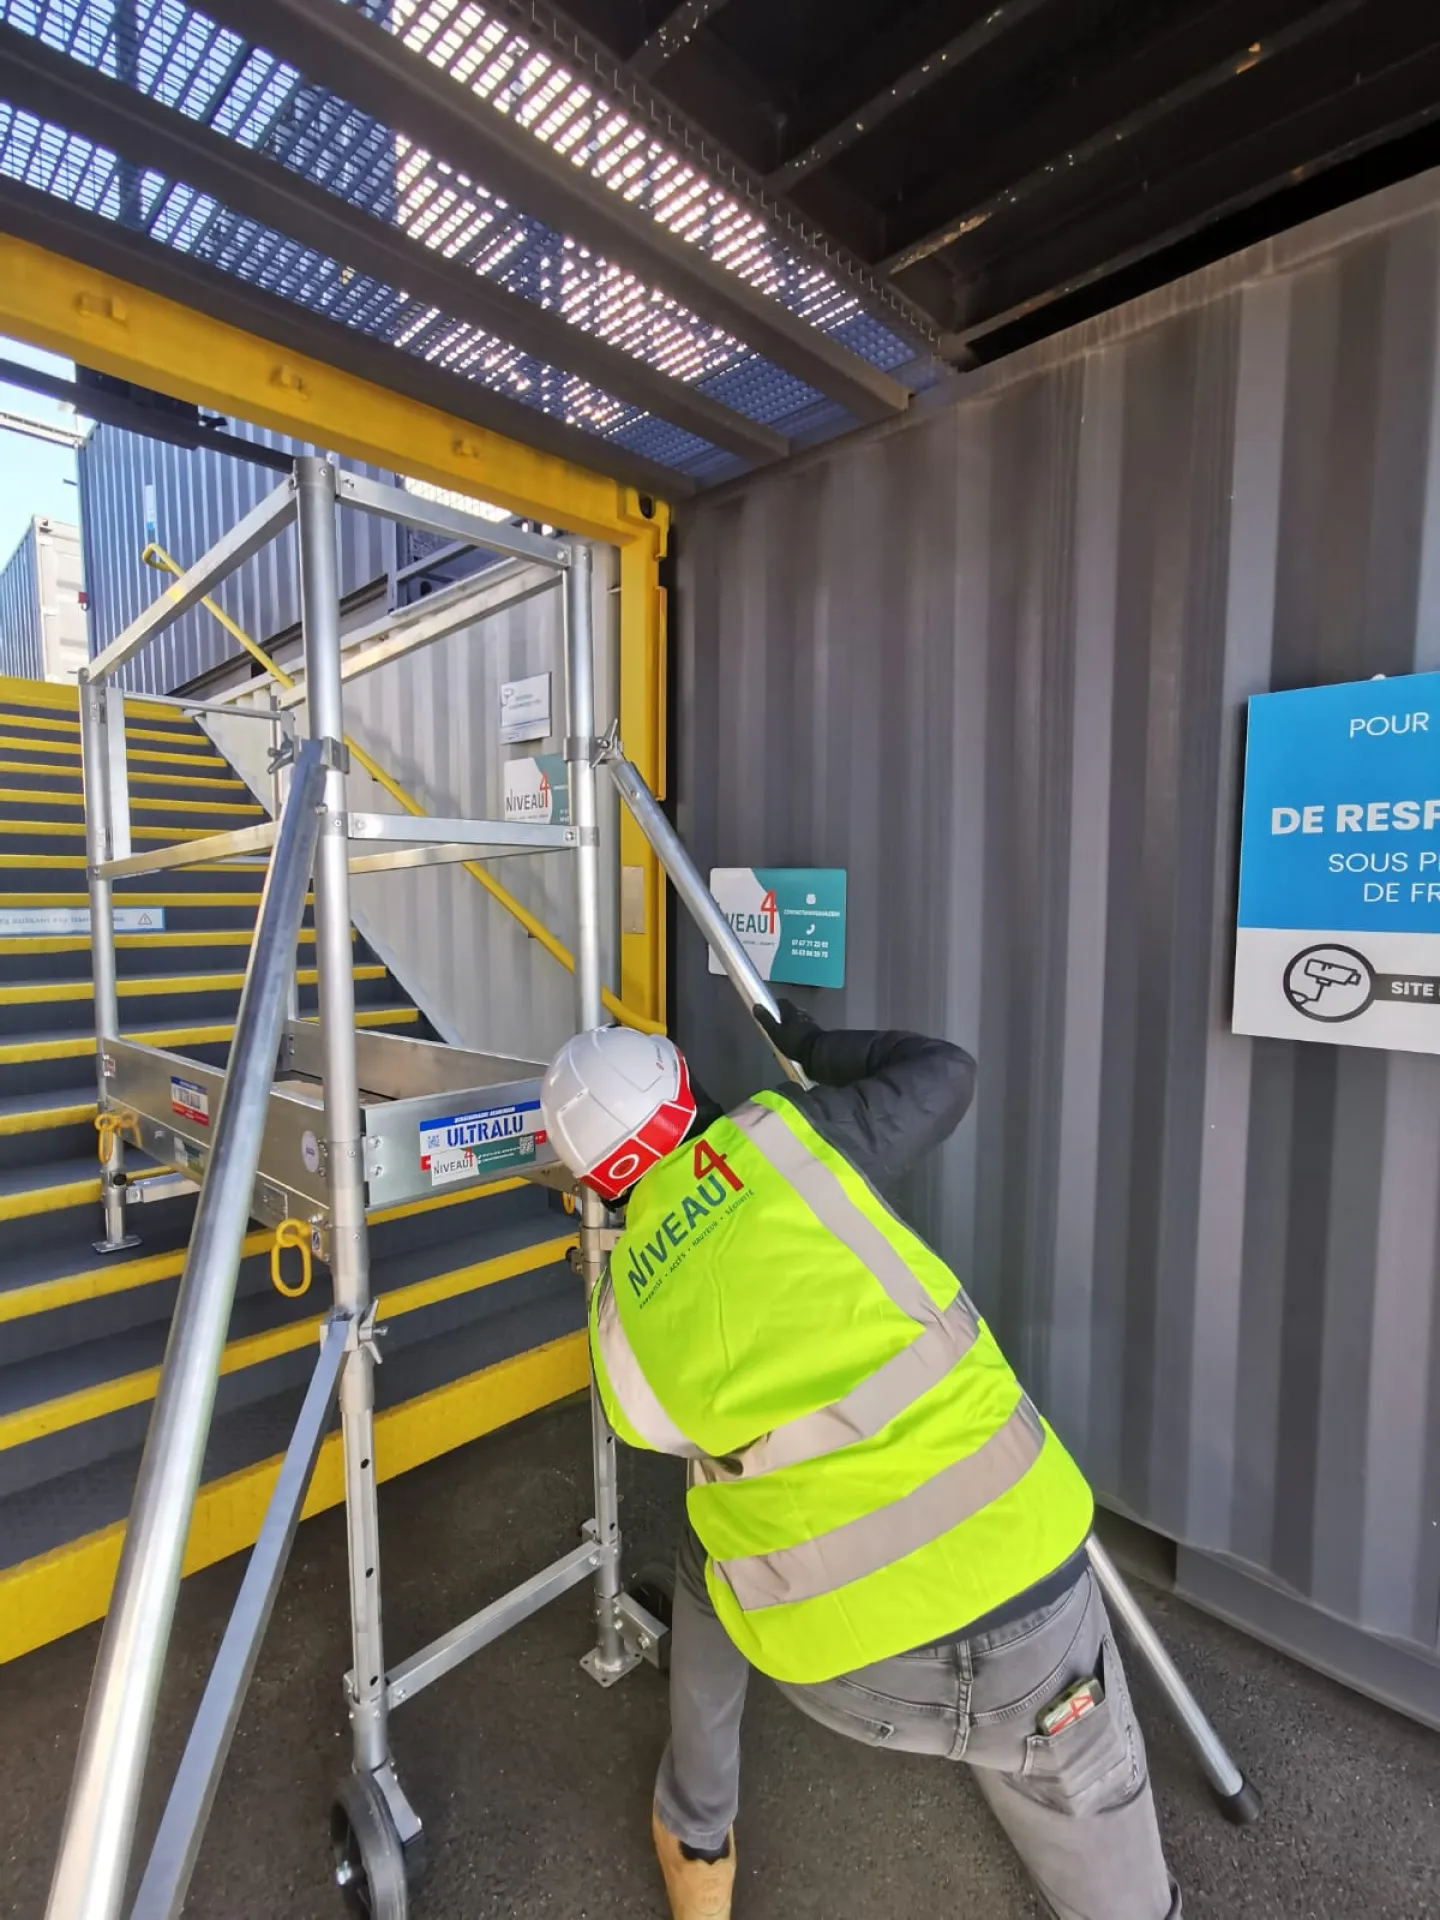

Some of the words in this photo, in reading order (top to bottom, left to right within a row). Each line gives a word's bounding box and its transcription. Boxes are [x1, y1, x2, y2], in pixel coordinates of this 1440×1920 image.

[1350, 712, 1429, 738] POUR
[1271, 805, 1325, 835] DE
[1328, 852, 1409, 873] SOUS
[1363, 882, 1400, 903] DE
[1391, 981, 1434, 997] SITE
[447, 1115, 523, 1147] ULTRALU
